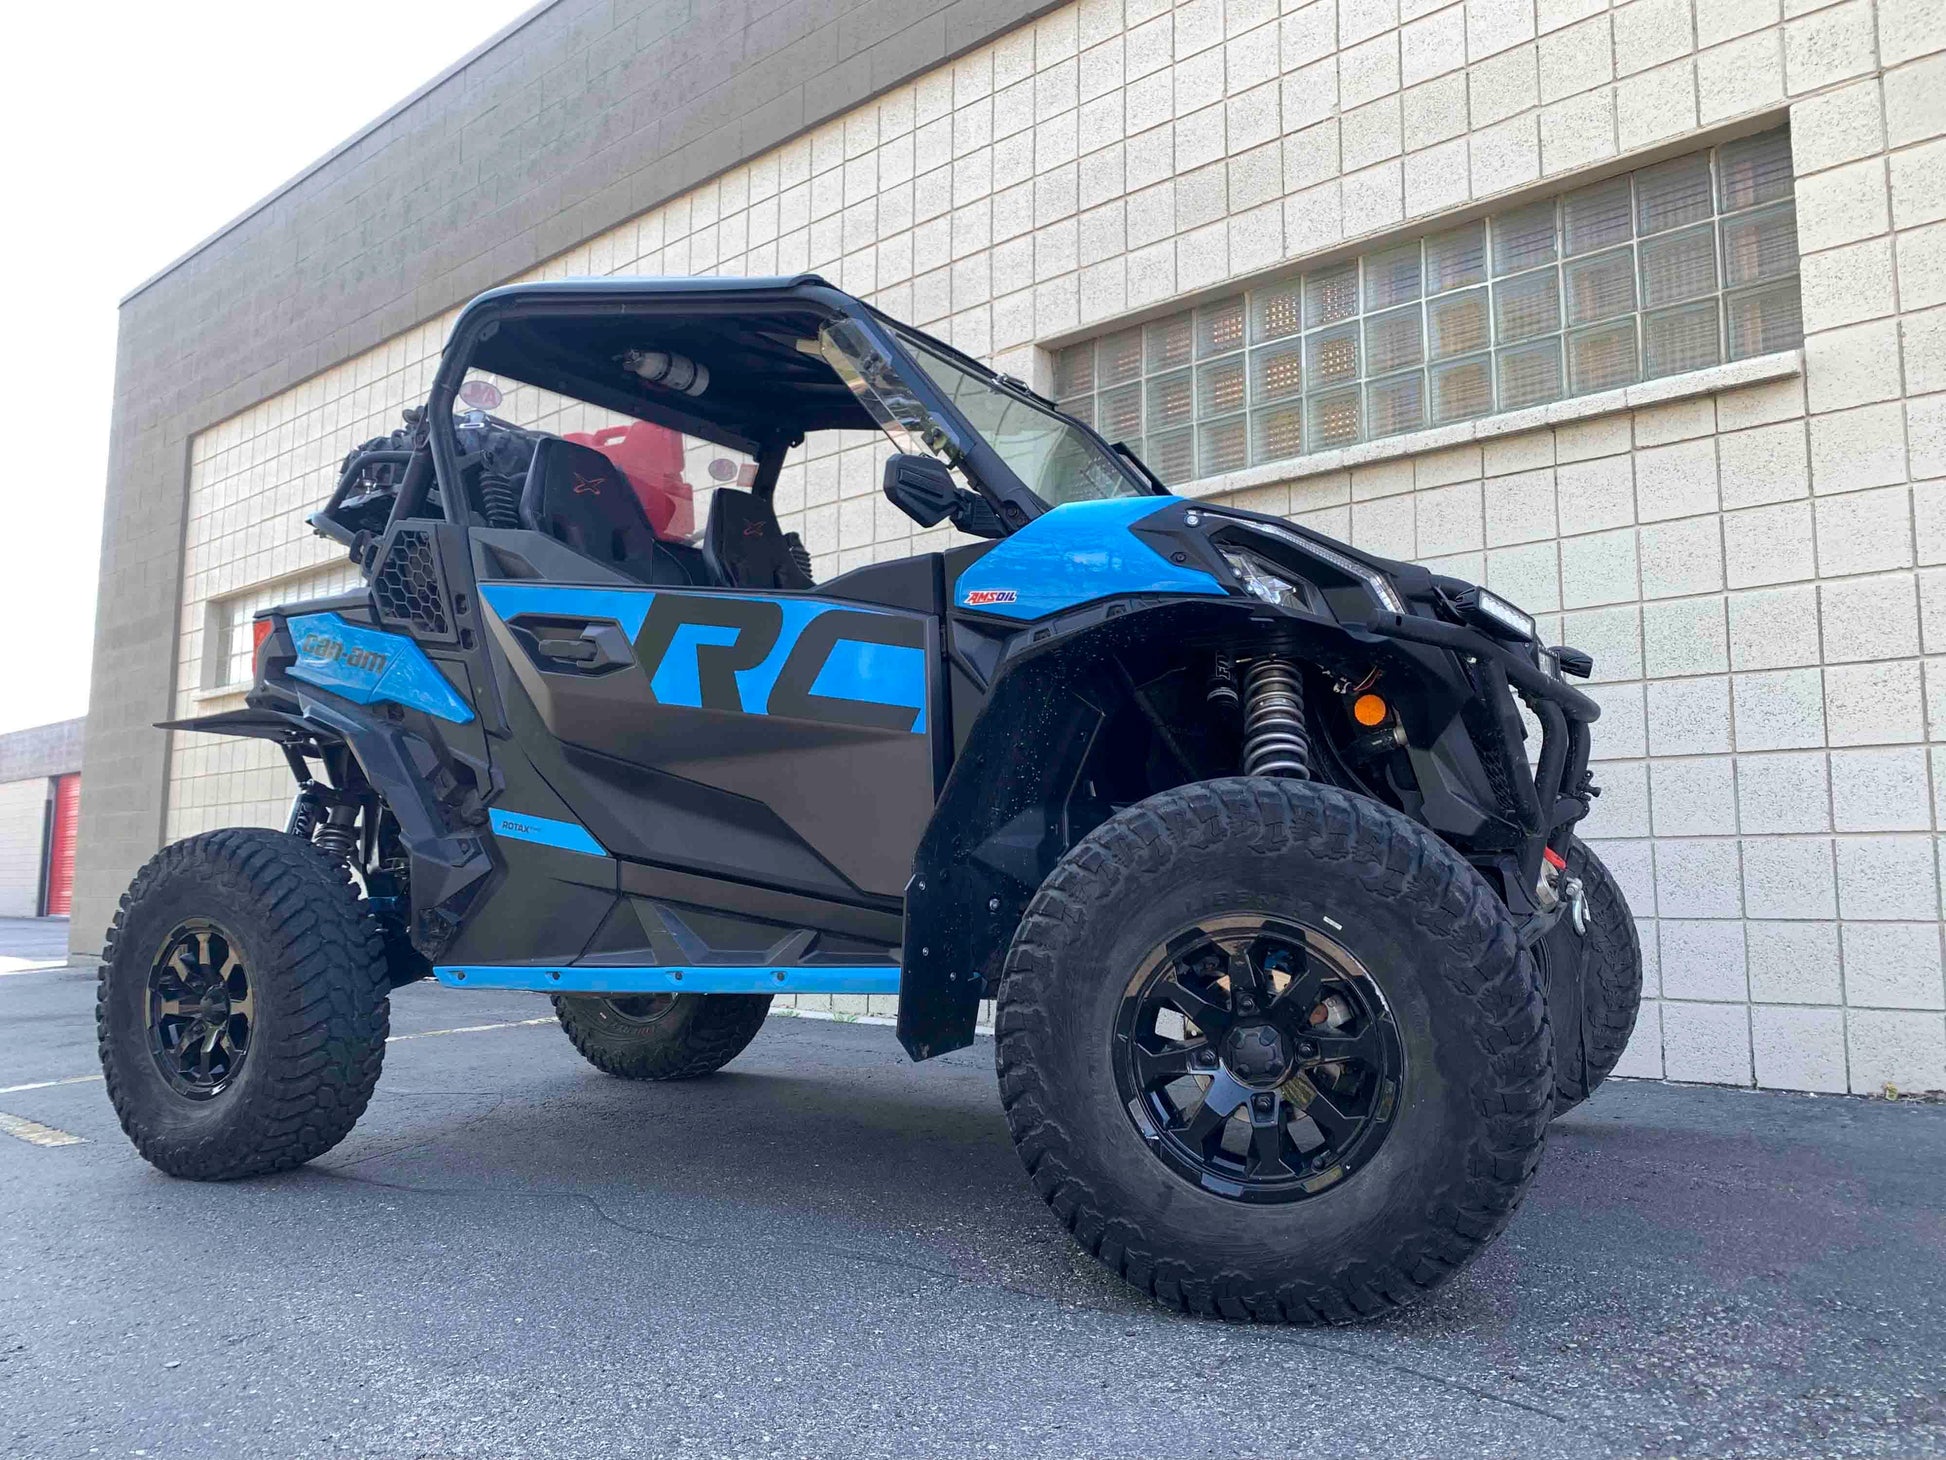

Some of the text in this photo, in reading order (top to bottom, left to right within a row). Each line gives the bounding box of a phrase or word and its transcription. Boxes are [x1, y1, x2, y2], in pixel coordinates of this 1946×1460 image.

[967, 591, 1017, 604] AMSOIL
[303, 634, 387, 674] can-am
[502, 820, 530, 833] ROTAX
